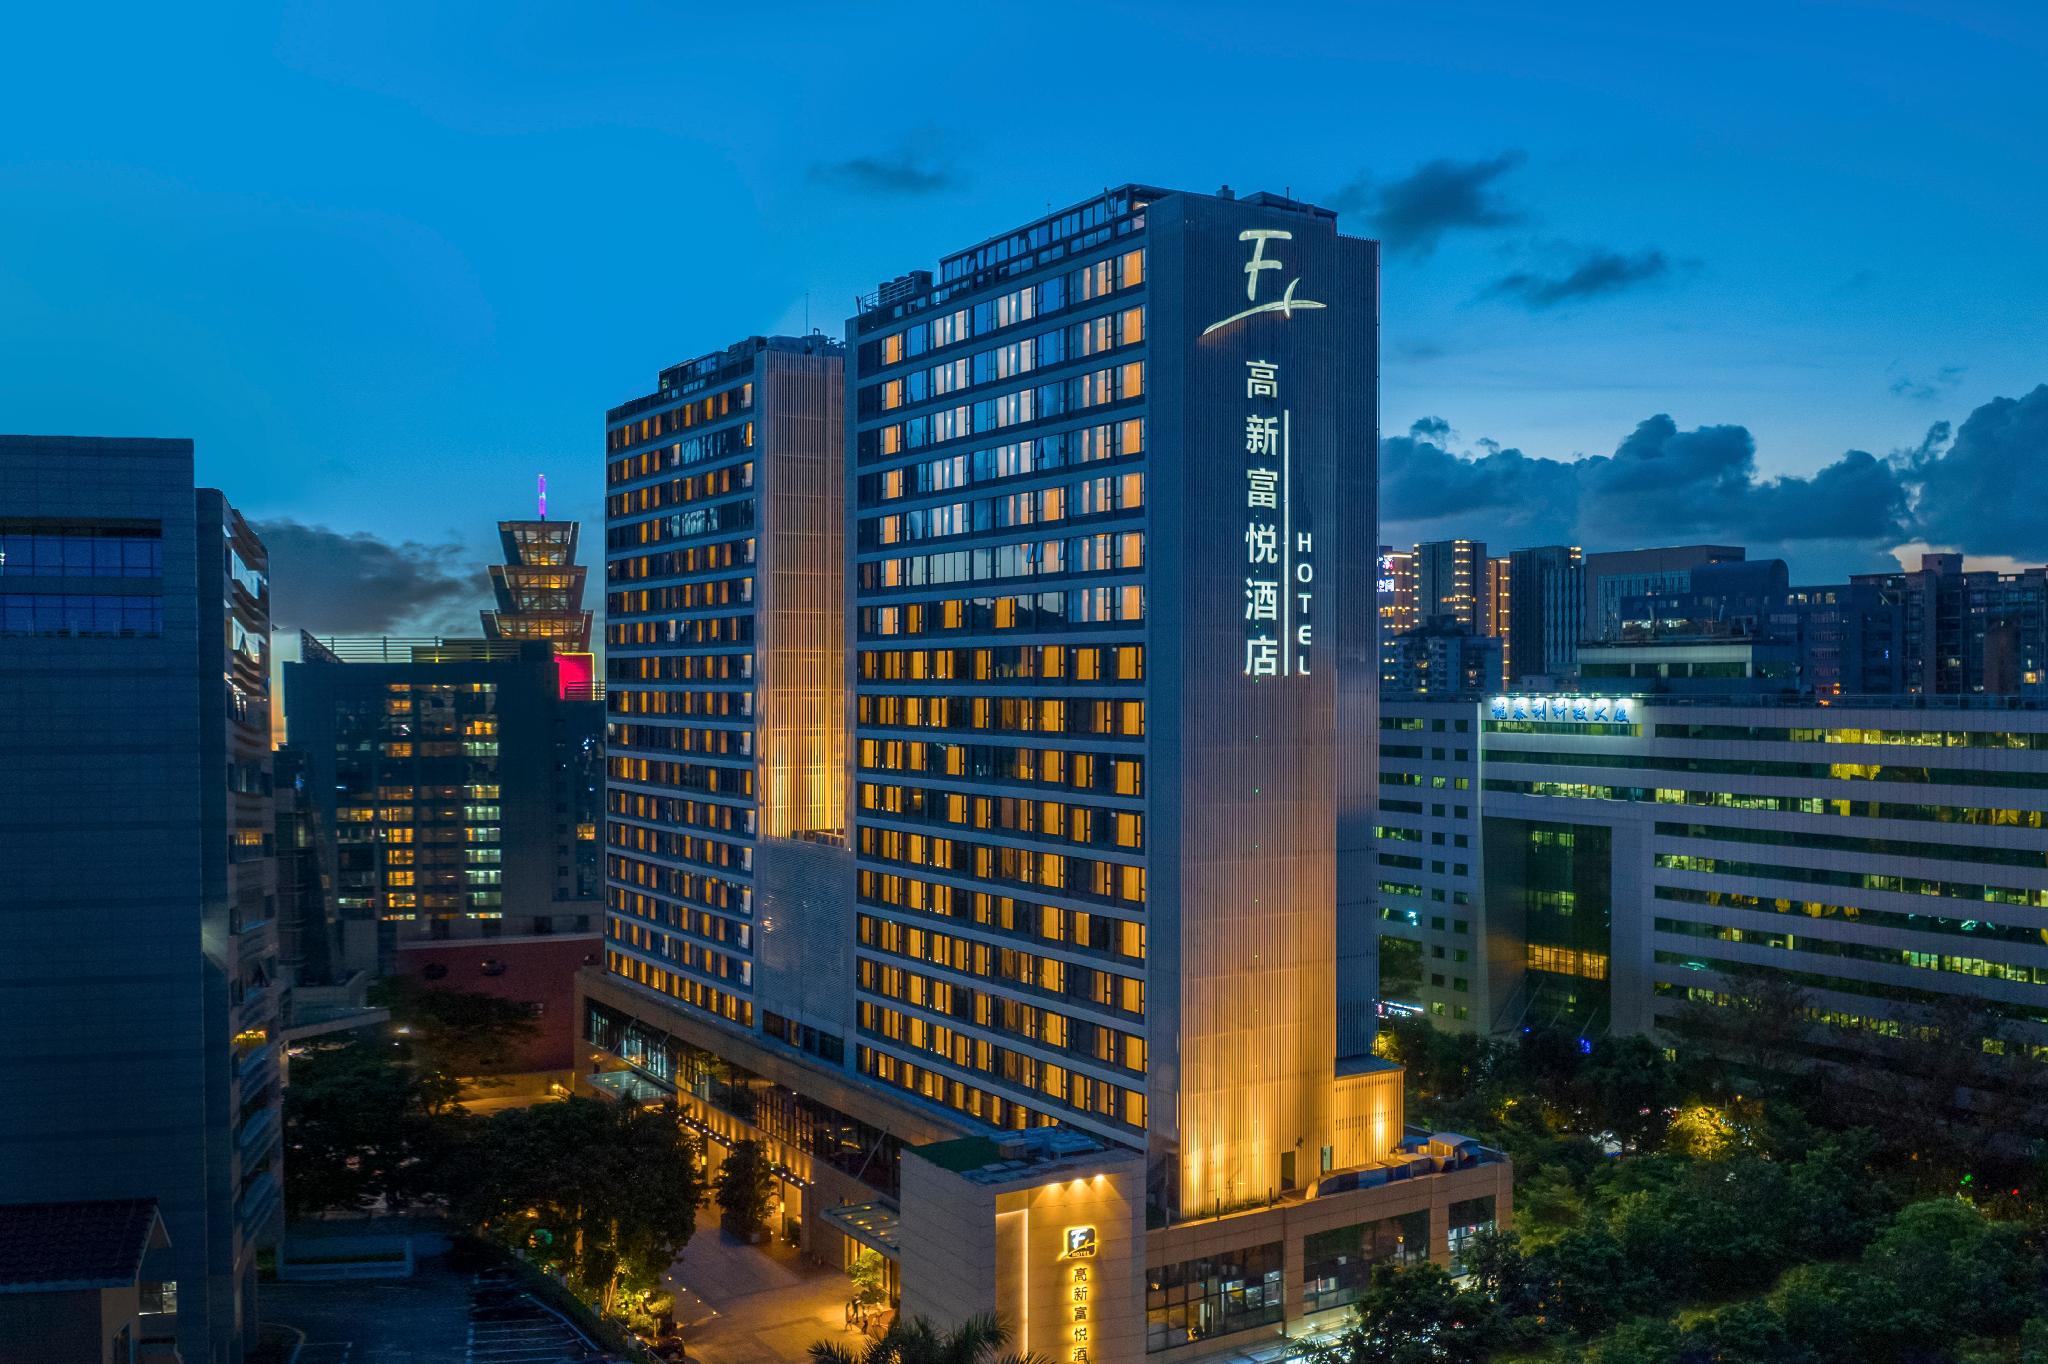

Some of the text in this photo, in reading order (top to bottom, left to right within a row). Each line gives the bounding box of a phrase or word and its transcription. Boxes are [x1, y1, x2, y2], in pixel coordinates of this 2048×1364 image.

[1245, 359, 1279, 676] 高新富悦酒店
[1297, 532, 1312, 675] HOTEL
[1073, 1267, 1088, 1362] 高新富悦酒
